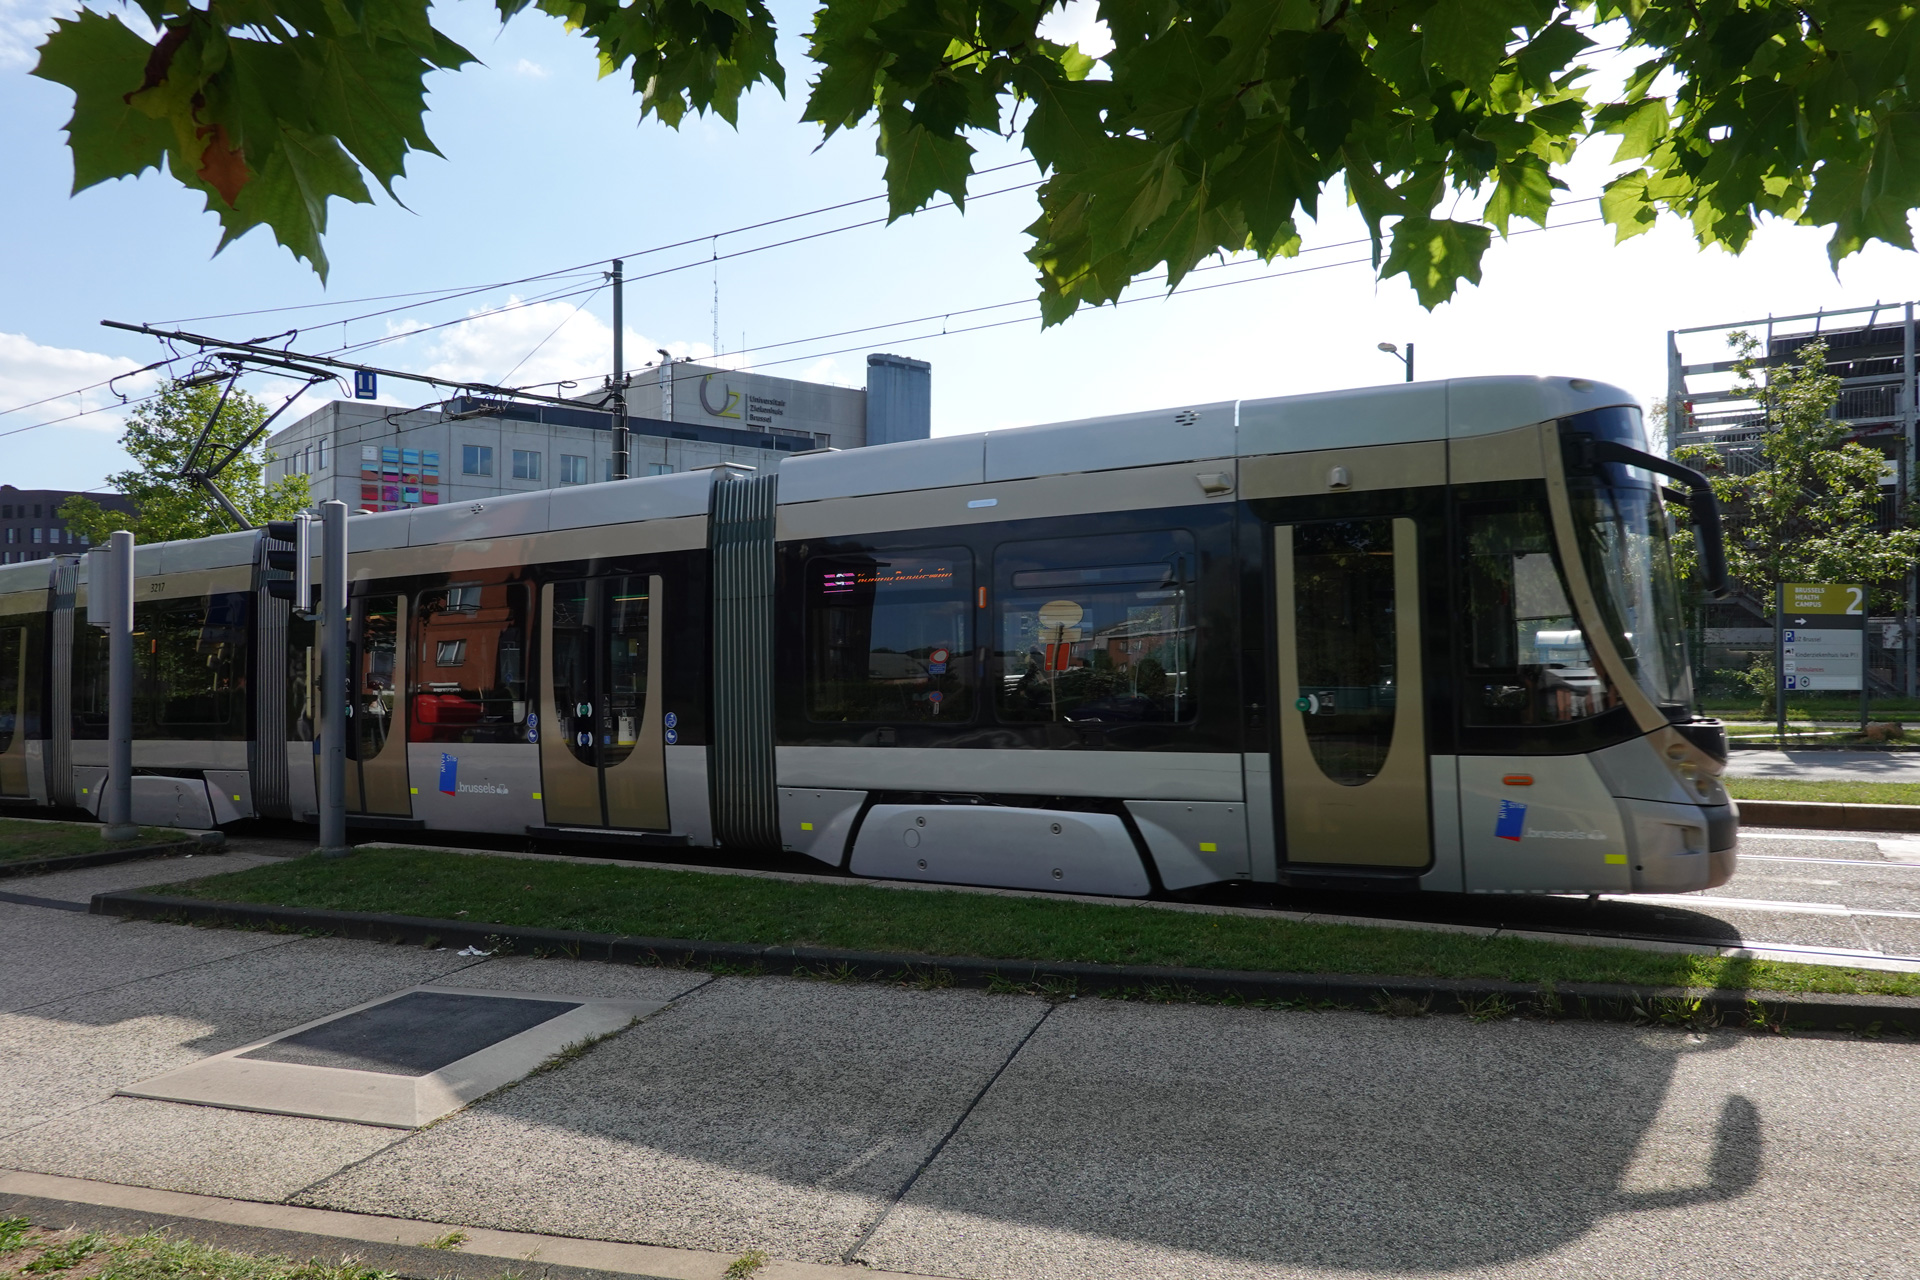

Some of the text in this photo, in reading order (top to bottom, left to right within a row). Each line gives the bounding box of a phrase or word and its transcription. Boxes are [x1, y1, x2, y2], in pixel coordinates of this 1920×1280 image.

[749, 395, 786, 407] Universitair
[749, 404, 784, 416] Ziekenhuis
[749, 413, 772, 423] Brussel
[150, 582, 165, 592] 3217
[1846, 587, 1863, 614] 2
